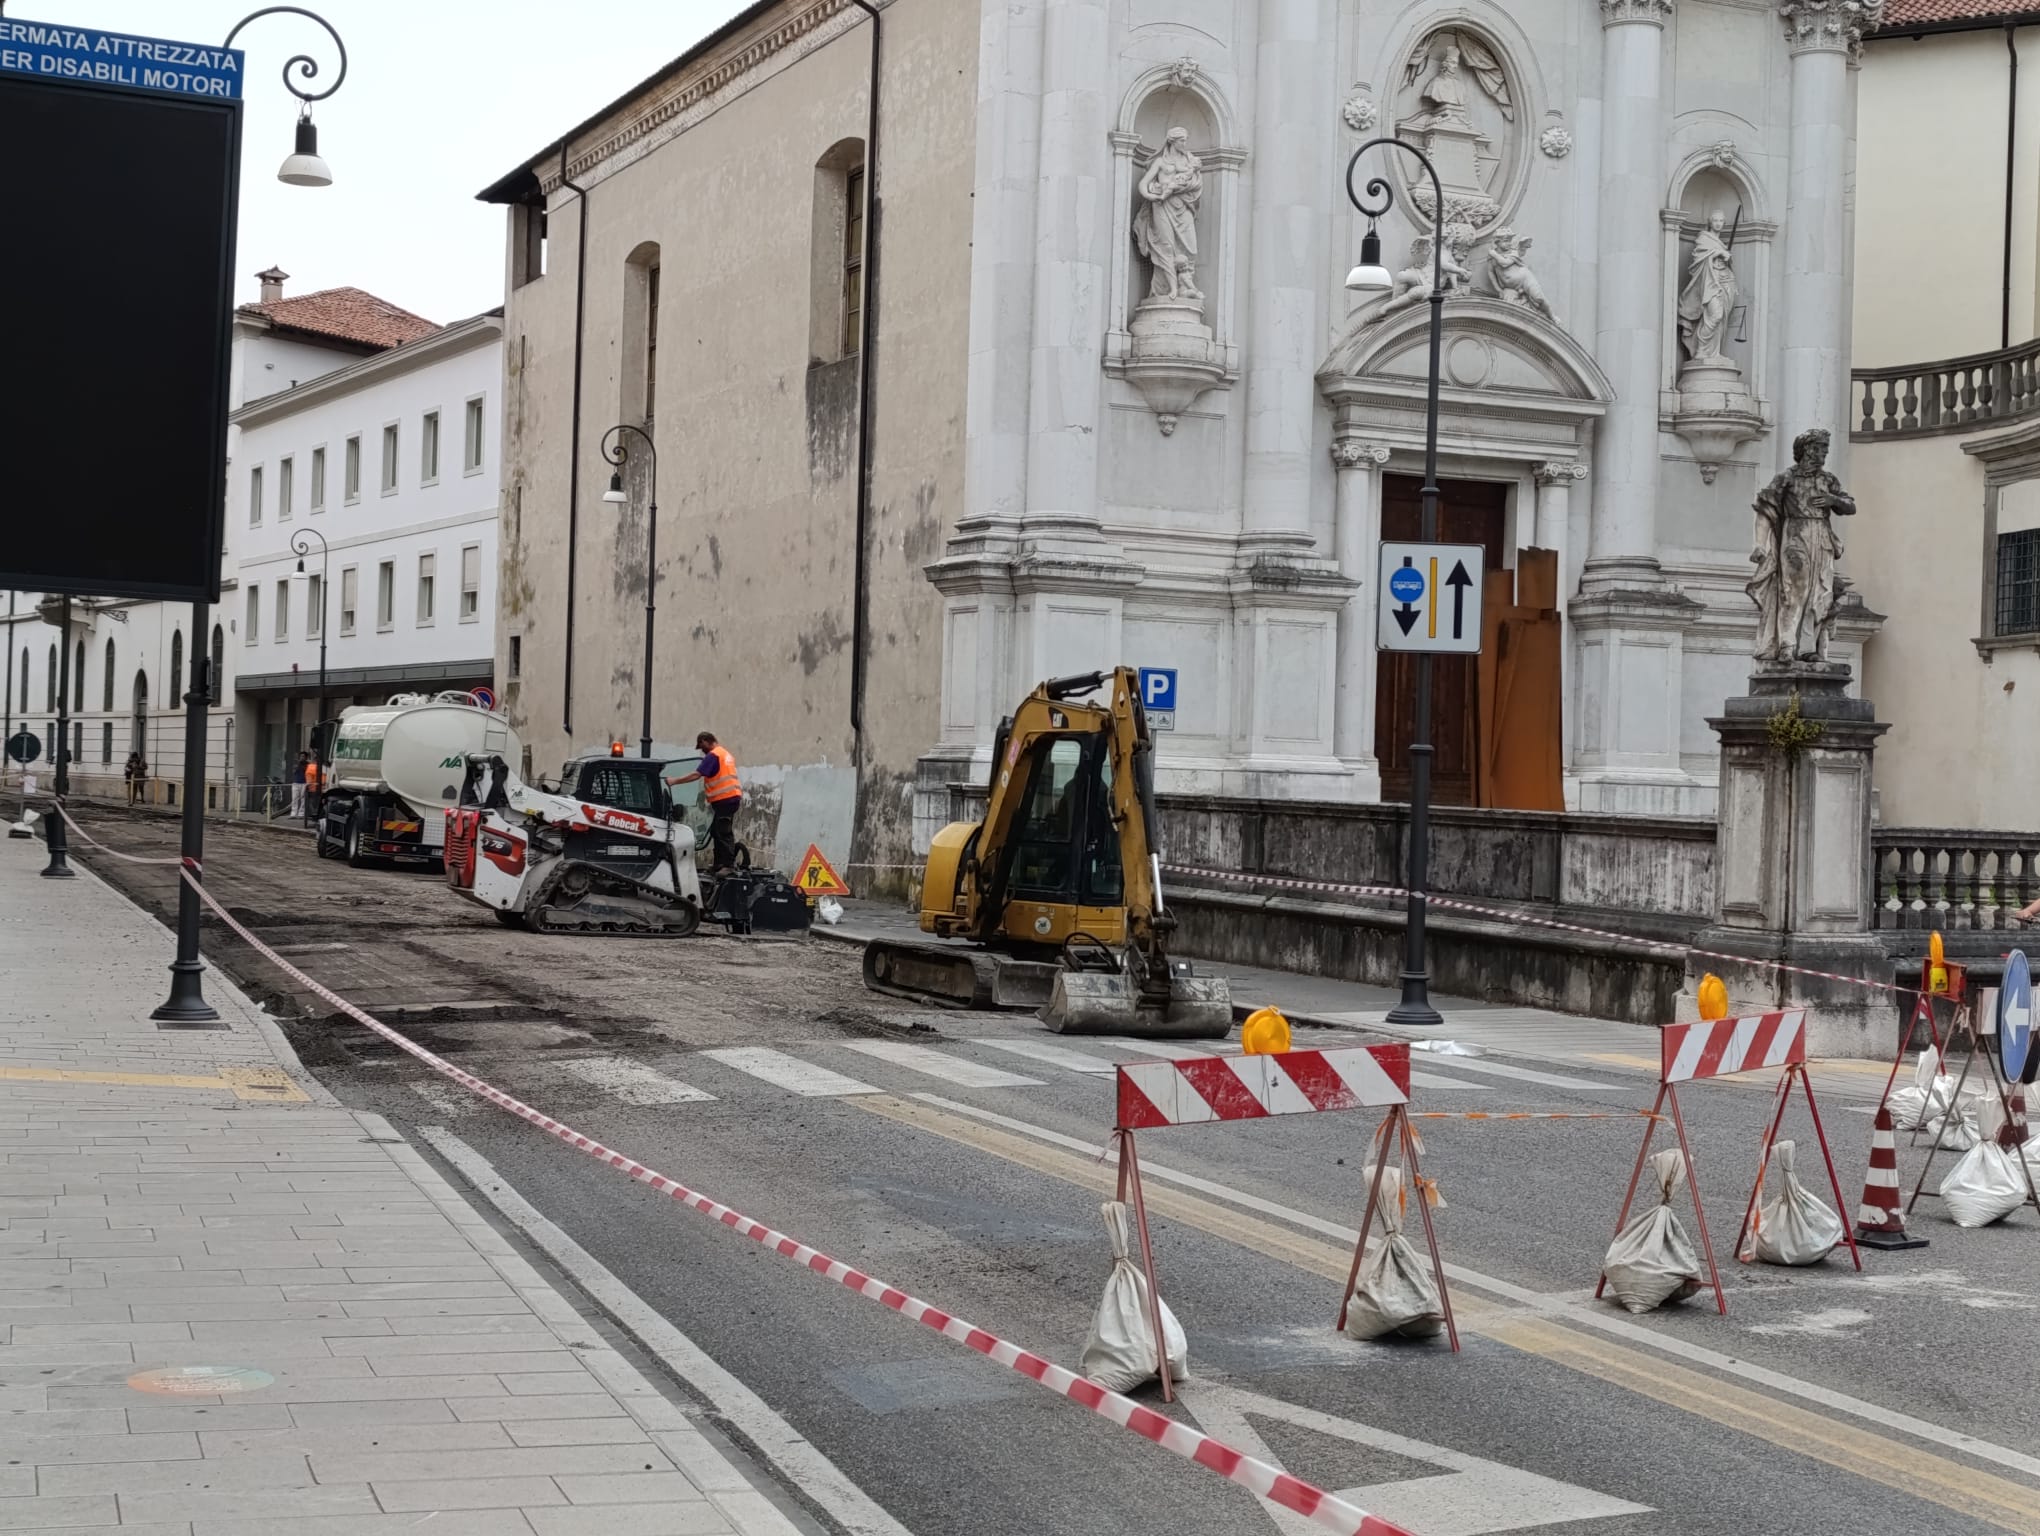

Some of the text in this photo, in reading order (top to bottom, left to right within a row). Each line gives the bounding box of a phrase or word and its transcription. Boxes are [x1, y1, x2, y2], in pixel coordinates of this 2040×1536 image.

[0, 22, 238, 72] ERMATA ATTREZZATA
[0, 49, 231, 97] ER DISABILI MOTORI
[1146, 673, 1169, 704] P
[608, 815, 640, 832] Bobcat
